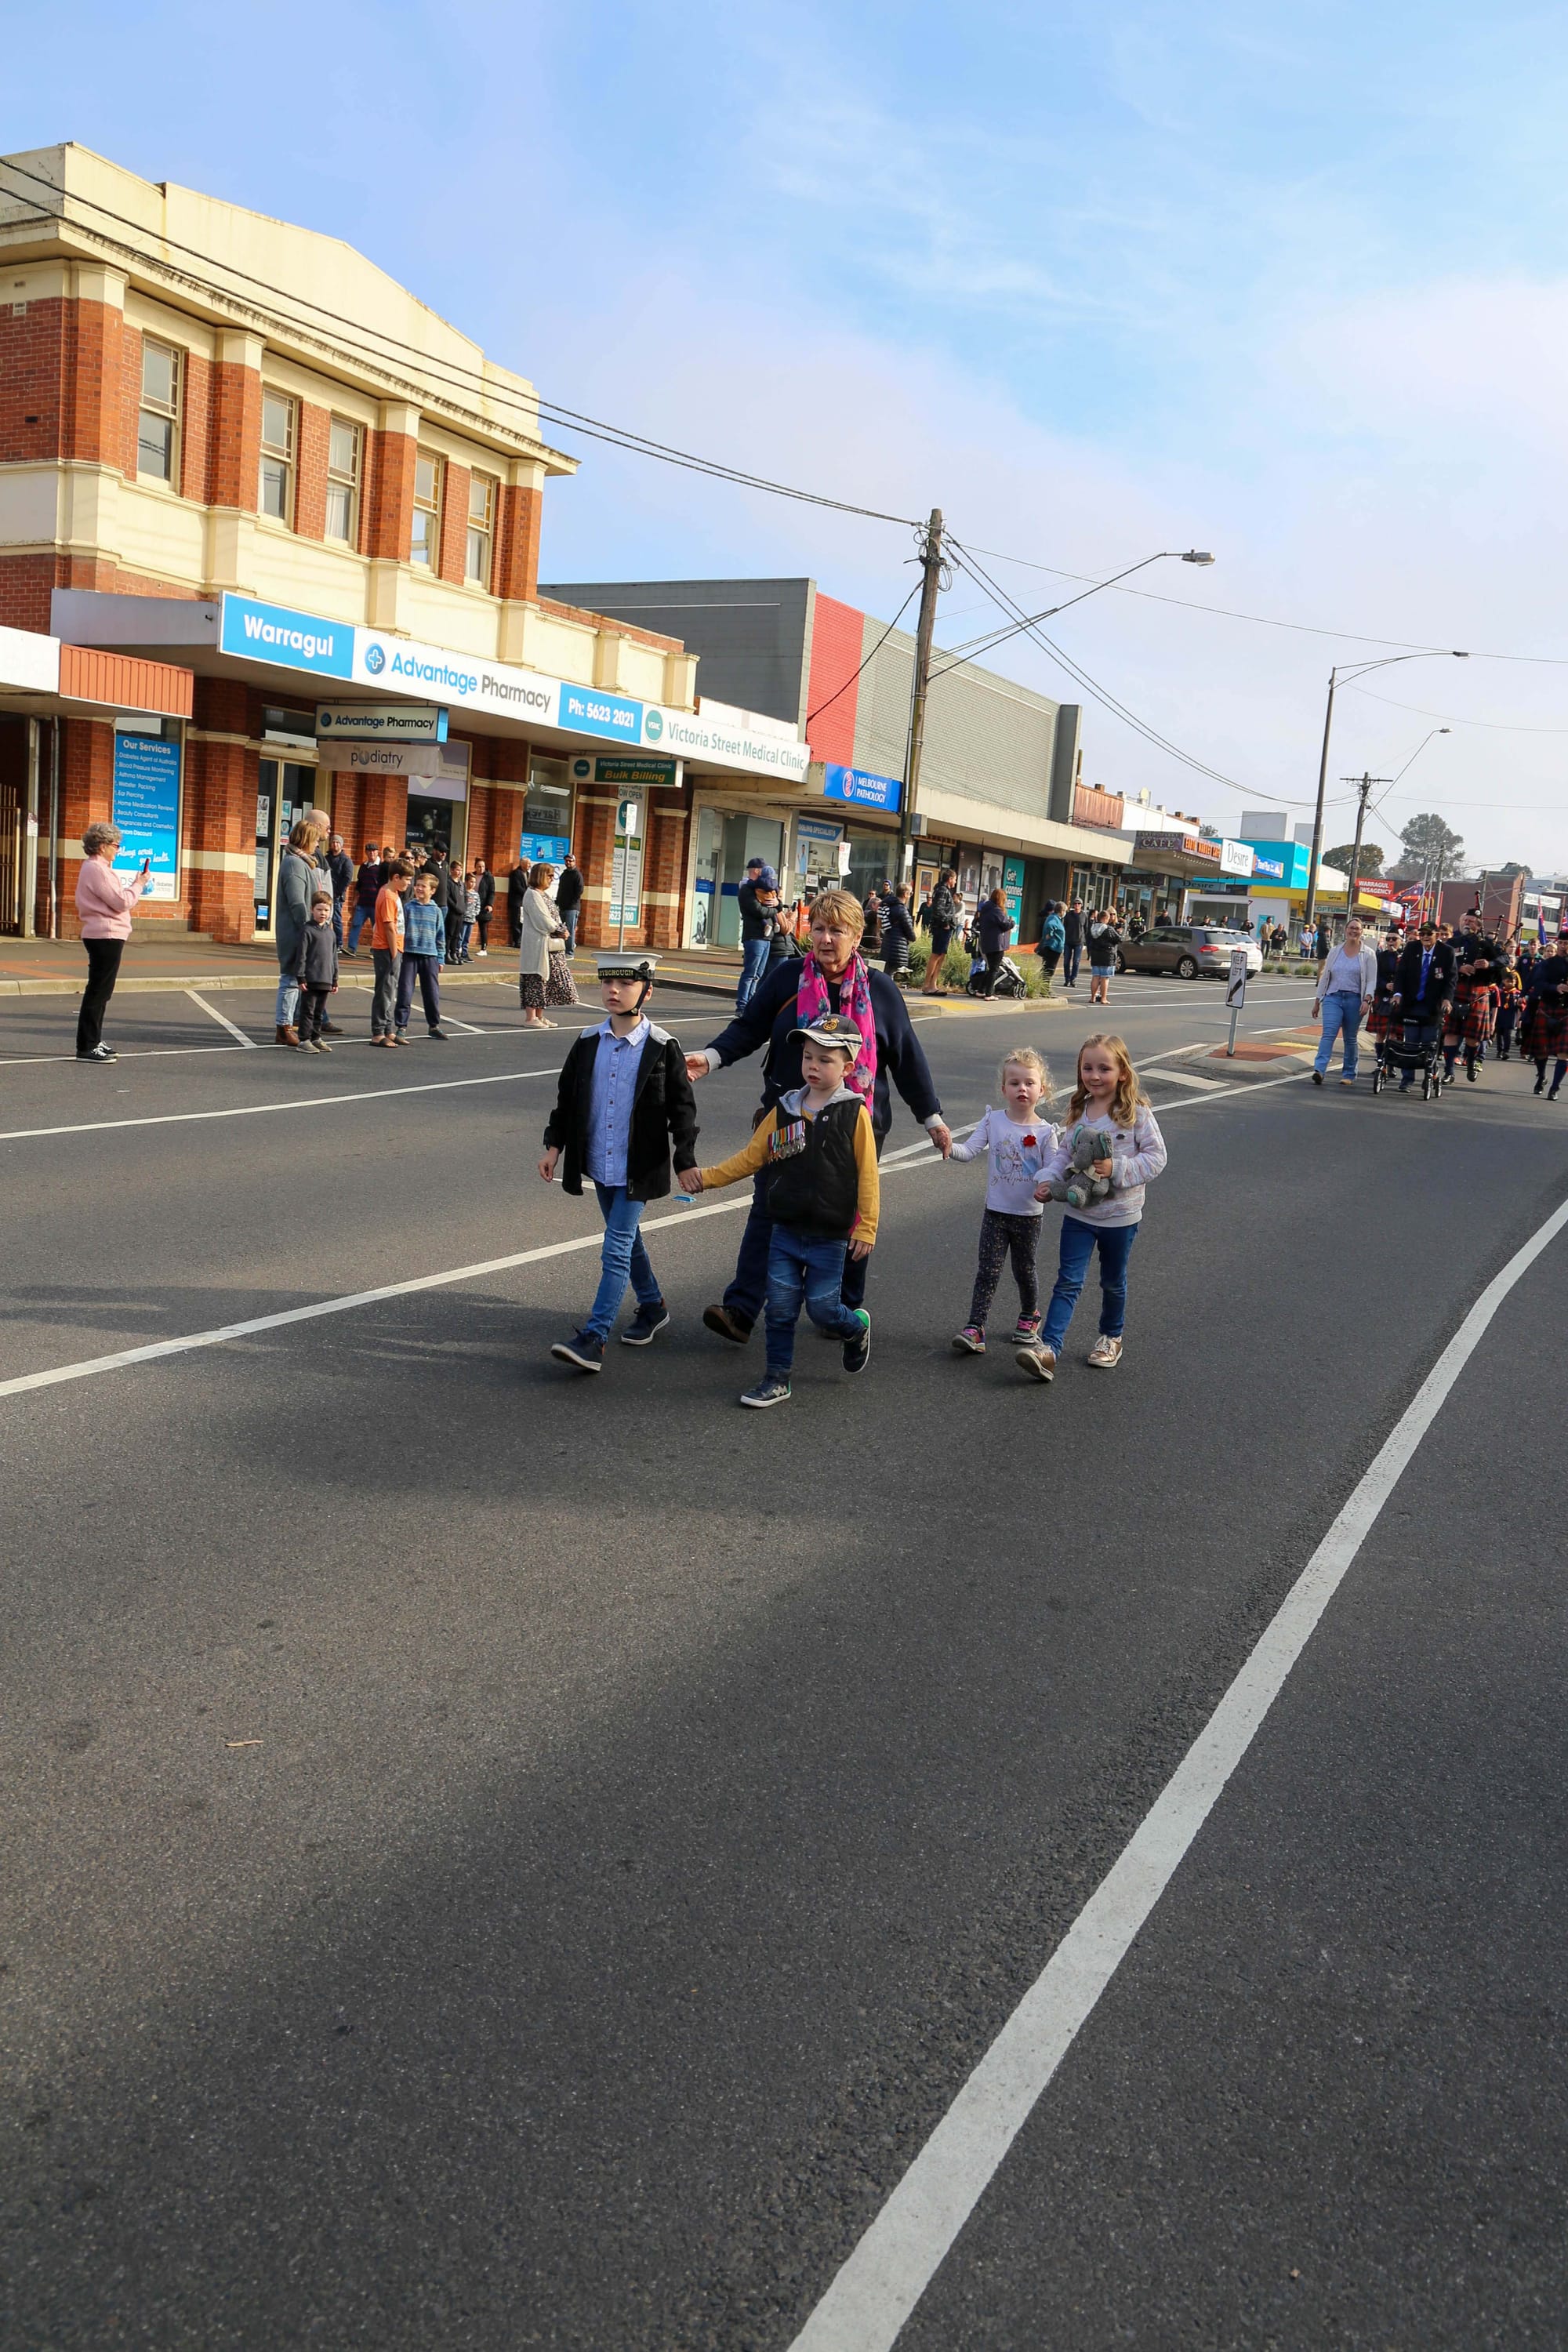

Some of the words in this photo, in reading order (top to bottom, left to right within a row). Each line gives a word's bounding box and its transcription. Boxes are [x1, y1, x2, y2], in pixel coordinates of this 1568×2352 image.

[244, 614, 334, 659] Warragul
[391, 652, 477, 695] Advantage
[481, 674, 551, 713] Pharmacy
[568, 697, 584, 717] Ph:
[586, 702, 611, 722] 5623
[612, 709, 634, 728] 2021
[335, 714, 385, 729] Advantage
[387, 716, 434, 730] Pharmacy
[648, 720, 662, 731] VSMC
[123, 739, 138, 750] Our
[139, 742, 172, 754] Services
[669, 721, 709, 748] Victoria
[711, 733, 741, 756] Street
[742, 742, 779, 764] Medical
[780, 750, 804, 771] Clinic
[350, 750, 404, 768] podiatry
[136, 773, 166, 782] Management
[604, 770, 628, 779] Bulk
[631, 771, 666, 782] Billing
[858, 776, 887, 793] MELBOURNE
[628, 790, 643, 800] OPEN
[856, 788, 887, 804] PATHOLOGY
[1142, 838, 1175, 848] CAFE
[1228, 843, 1250, 868] Desire
[1007, 868, 1017, 882] Get
[1005, 885, 1023, 897] connec
[1182, 880, 1215, 889] Desire
[1358, 880, 1390, 889] WARRAGUL
[1359, 887, 1392, 896] WSAGENCY
[1233, 955, 1243, 965] KEEP
[1232, 967, 1243, 976] LEFT
